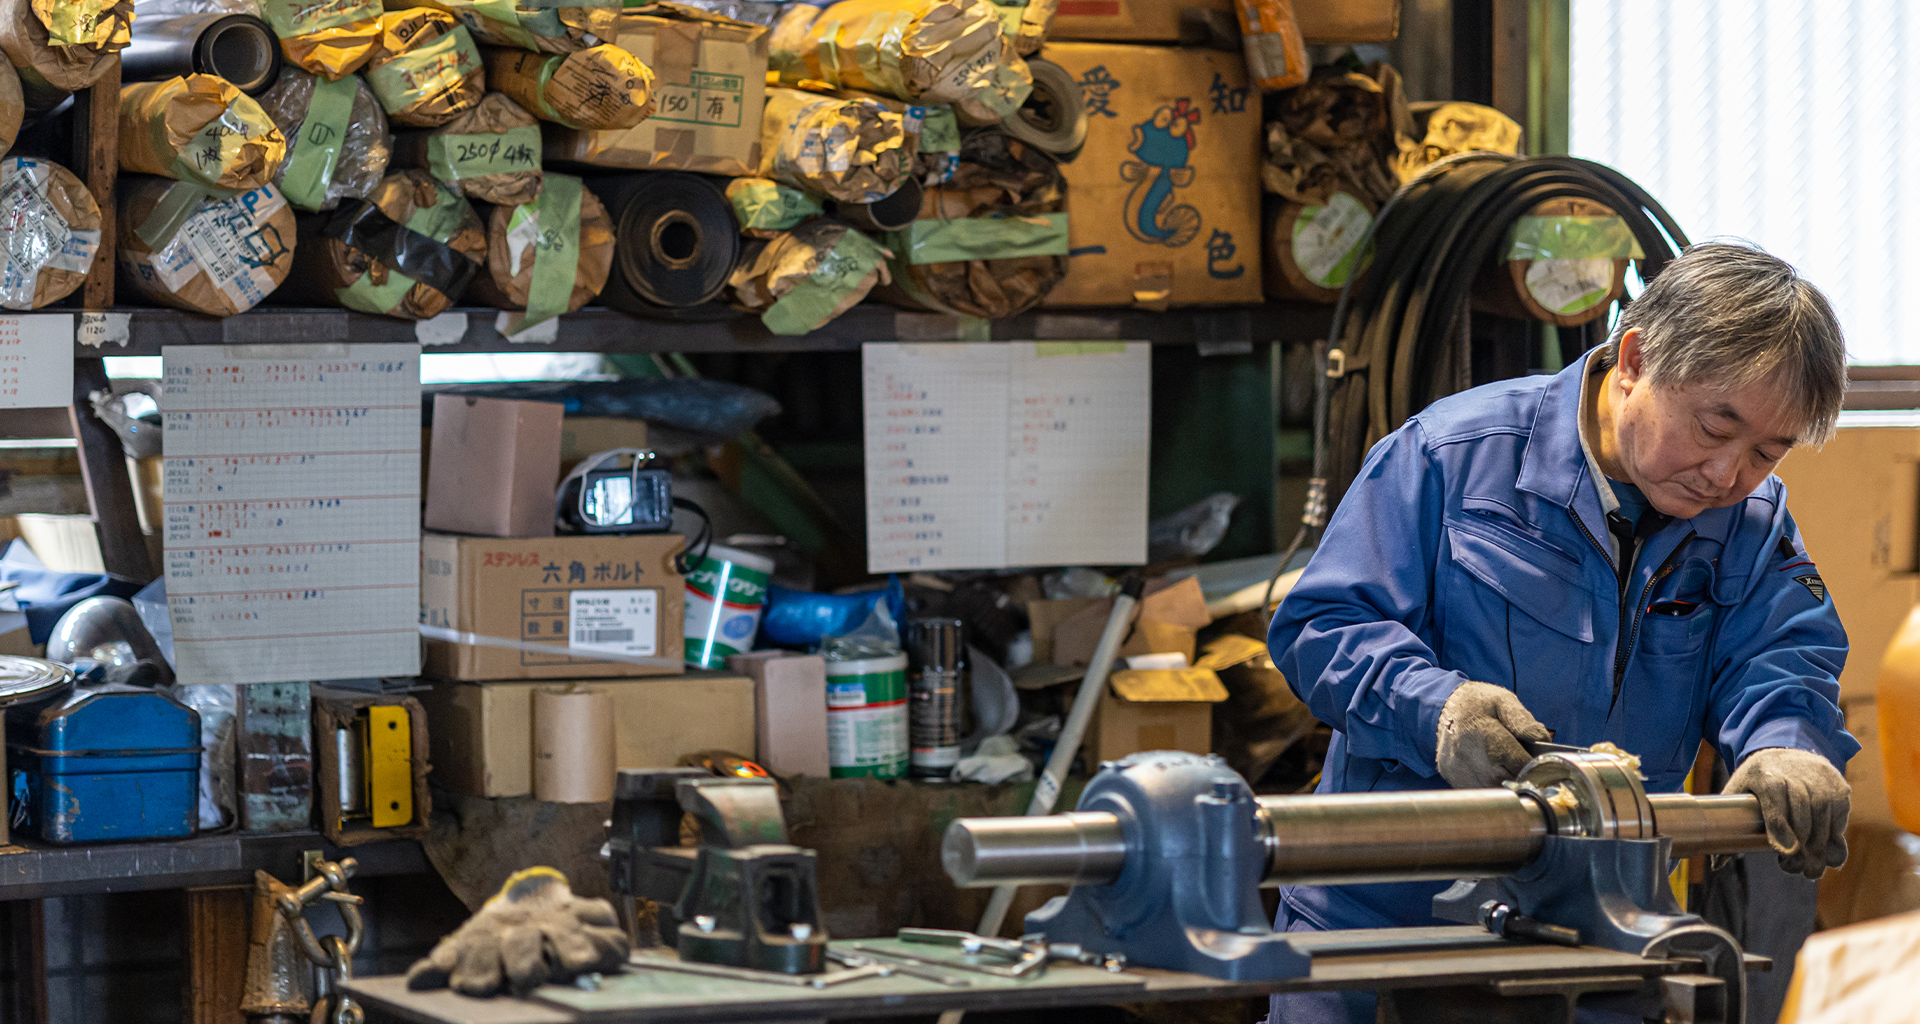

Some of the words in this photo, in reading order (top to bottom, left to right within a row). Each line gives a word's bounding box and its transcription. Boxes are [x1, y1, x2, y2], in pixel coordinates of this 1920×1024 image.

[400, 21, 418, 38] OJI
[1078, 65, 1121, 118] 愛
[1209, 72, 1247, 115] 知
[661, 93, 689, 113] 150
[1204, 228, 1245, 280] 色
[483, 552, 539, 568] ステンレス
[542, 561, 644, 584] 六角ボルト
